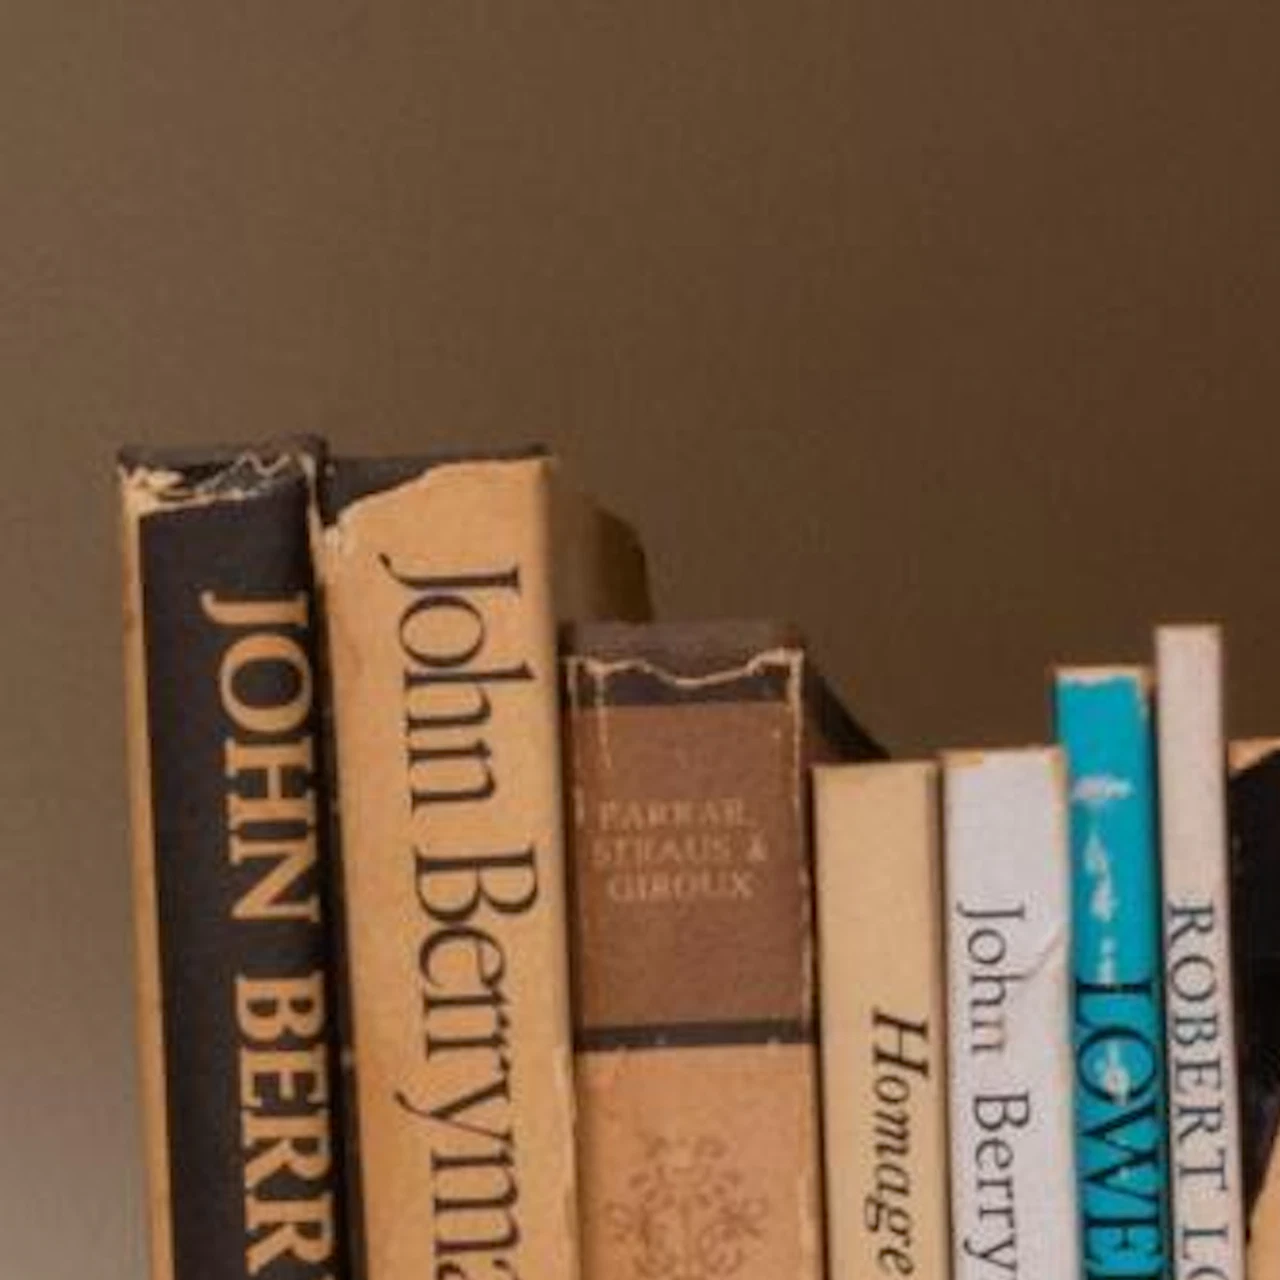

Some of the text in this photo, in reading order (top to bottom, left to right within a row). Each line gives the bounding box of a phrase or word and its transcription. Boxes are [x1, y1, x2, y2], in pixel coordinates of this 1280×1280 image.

[200, 590, 319, 922] JOHN
[379, 552, 535, 818] John
[592, 836, 732, 868] STRAUS
[608, 871, 755, 902] GIROUX
[956, 901, 1027, 1055] John
[864, 1005, 931, 1276] Homage
[1168, 899, 1230, 1191] ROBERT
